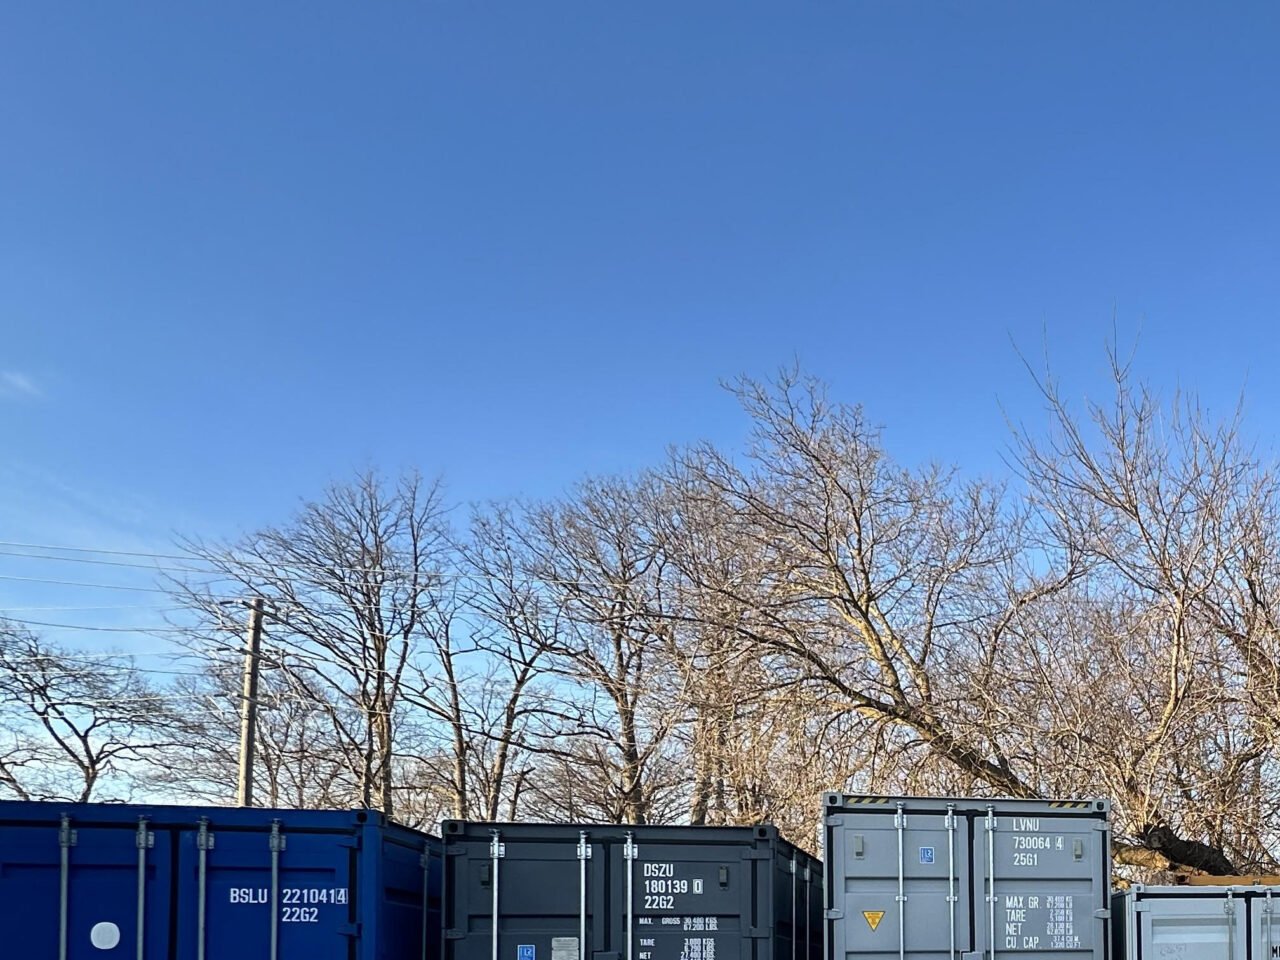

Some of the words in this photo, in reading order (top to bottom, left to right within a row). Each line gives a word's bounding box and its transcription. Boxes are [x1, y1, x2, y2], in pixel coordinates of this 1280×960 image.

[1013, 818, 1040, 831] LVNU
[1012, 836, 1051, 849] 730064
[1055, 836, 1064, 850] 4
[1013, 853, 1038, 866] 25G1
[643, 863, 674, 877] DSZU
[645, 879, 688, 894] 180139
[693, 879, 703, 894] 0
[229, 888, 268, 904] BSLU
[644, 895, 674, 909] 22G2
[281, 907, 319, 922] 22G2
[1005, 909, 1027, 922] TARE
[1005, 922, 1023, 936] NET
[640, 938, 656, 947] TARE
[639, 952, 652, 960] NET
